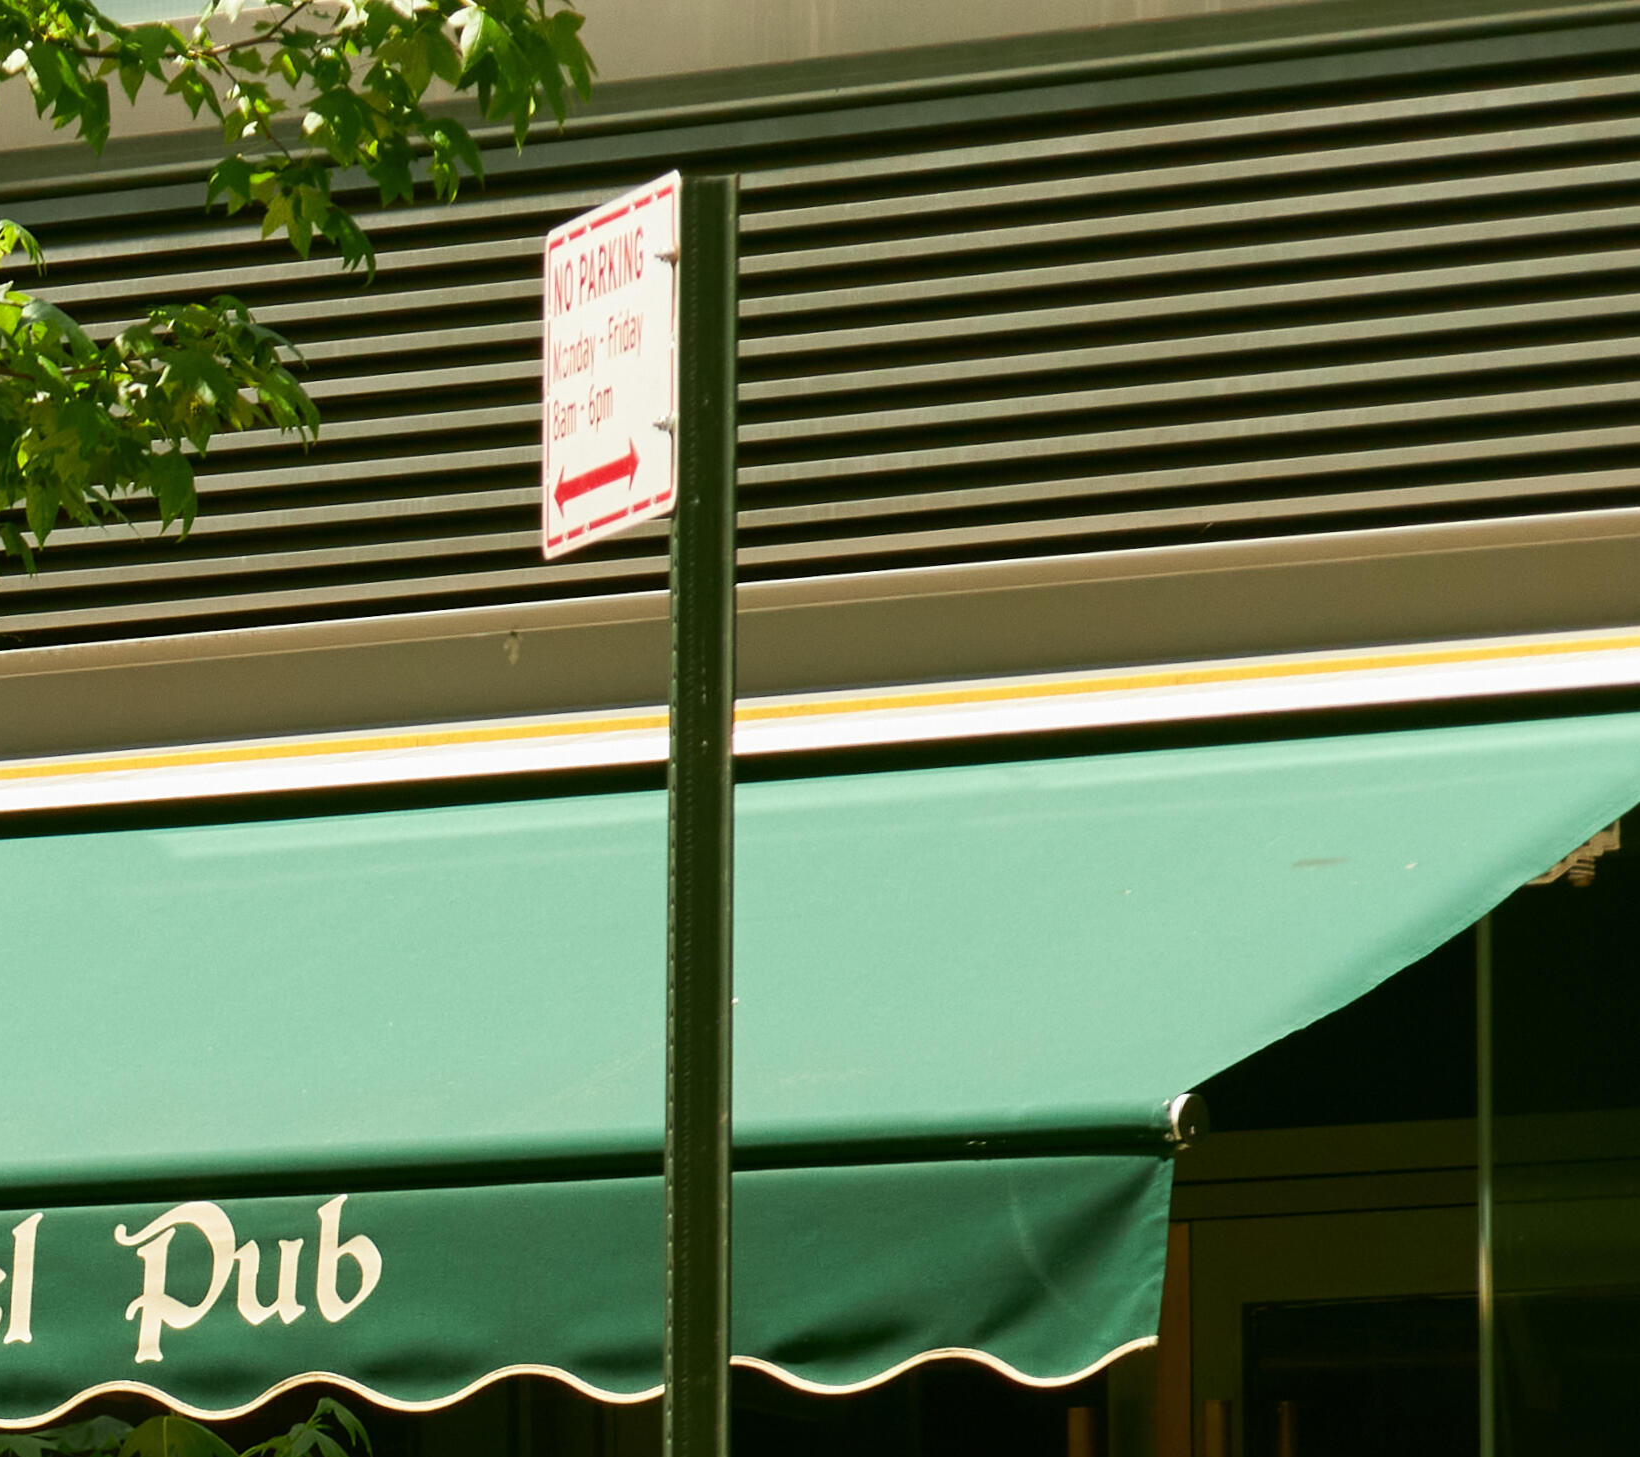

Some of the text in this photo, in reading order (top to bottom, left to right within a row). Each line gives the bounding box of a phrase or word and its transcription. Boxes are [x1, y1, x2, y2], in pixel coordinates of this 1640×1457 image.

[554, 225, 644, 317] NO PARKING
[553, 328, 596, 384] Monday
[608, 306, 644, 358] Friday
[553, 399, 577, 441] 8am
[588, 383, 614, 433] 6pm
[114, 1194, 383, 1364] Pub
